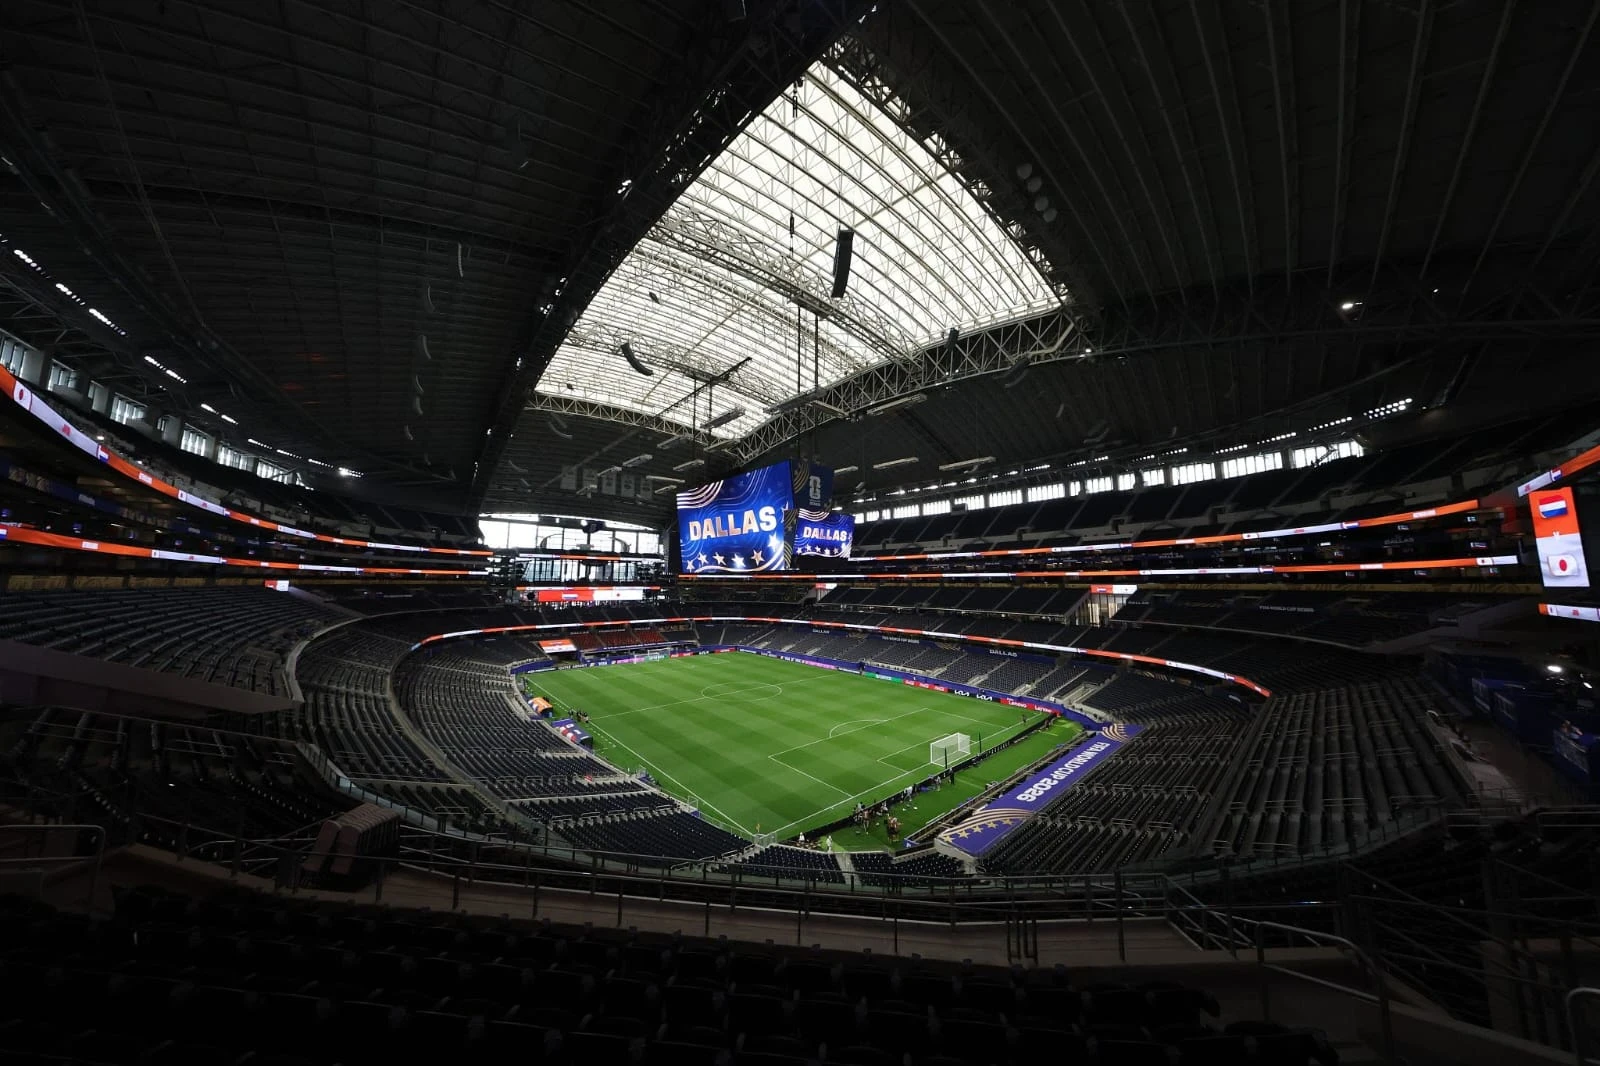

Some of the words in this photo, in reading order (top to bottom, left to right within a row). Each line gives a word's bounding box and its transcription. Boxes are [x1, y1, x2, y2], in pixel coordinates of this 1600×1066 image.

[689, 506, 777, 541] DALLAS
[803, 526, 847, 541] DALLAS
[989, 649, 1018, 658] DALLAS
[1086, 741, 1111, 752] FIFA
[1064, 751, 1099, 769] WORLD
[1050, 767, 1074, 780] CUP
[1016, 778, 1059, 802] 2026
